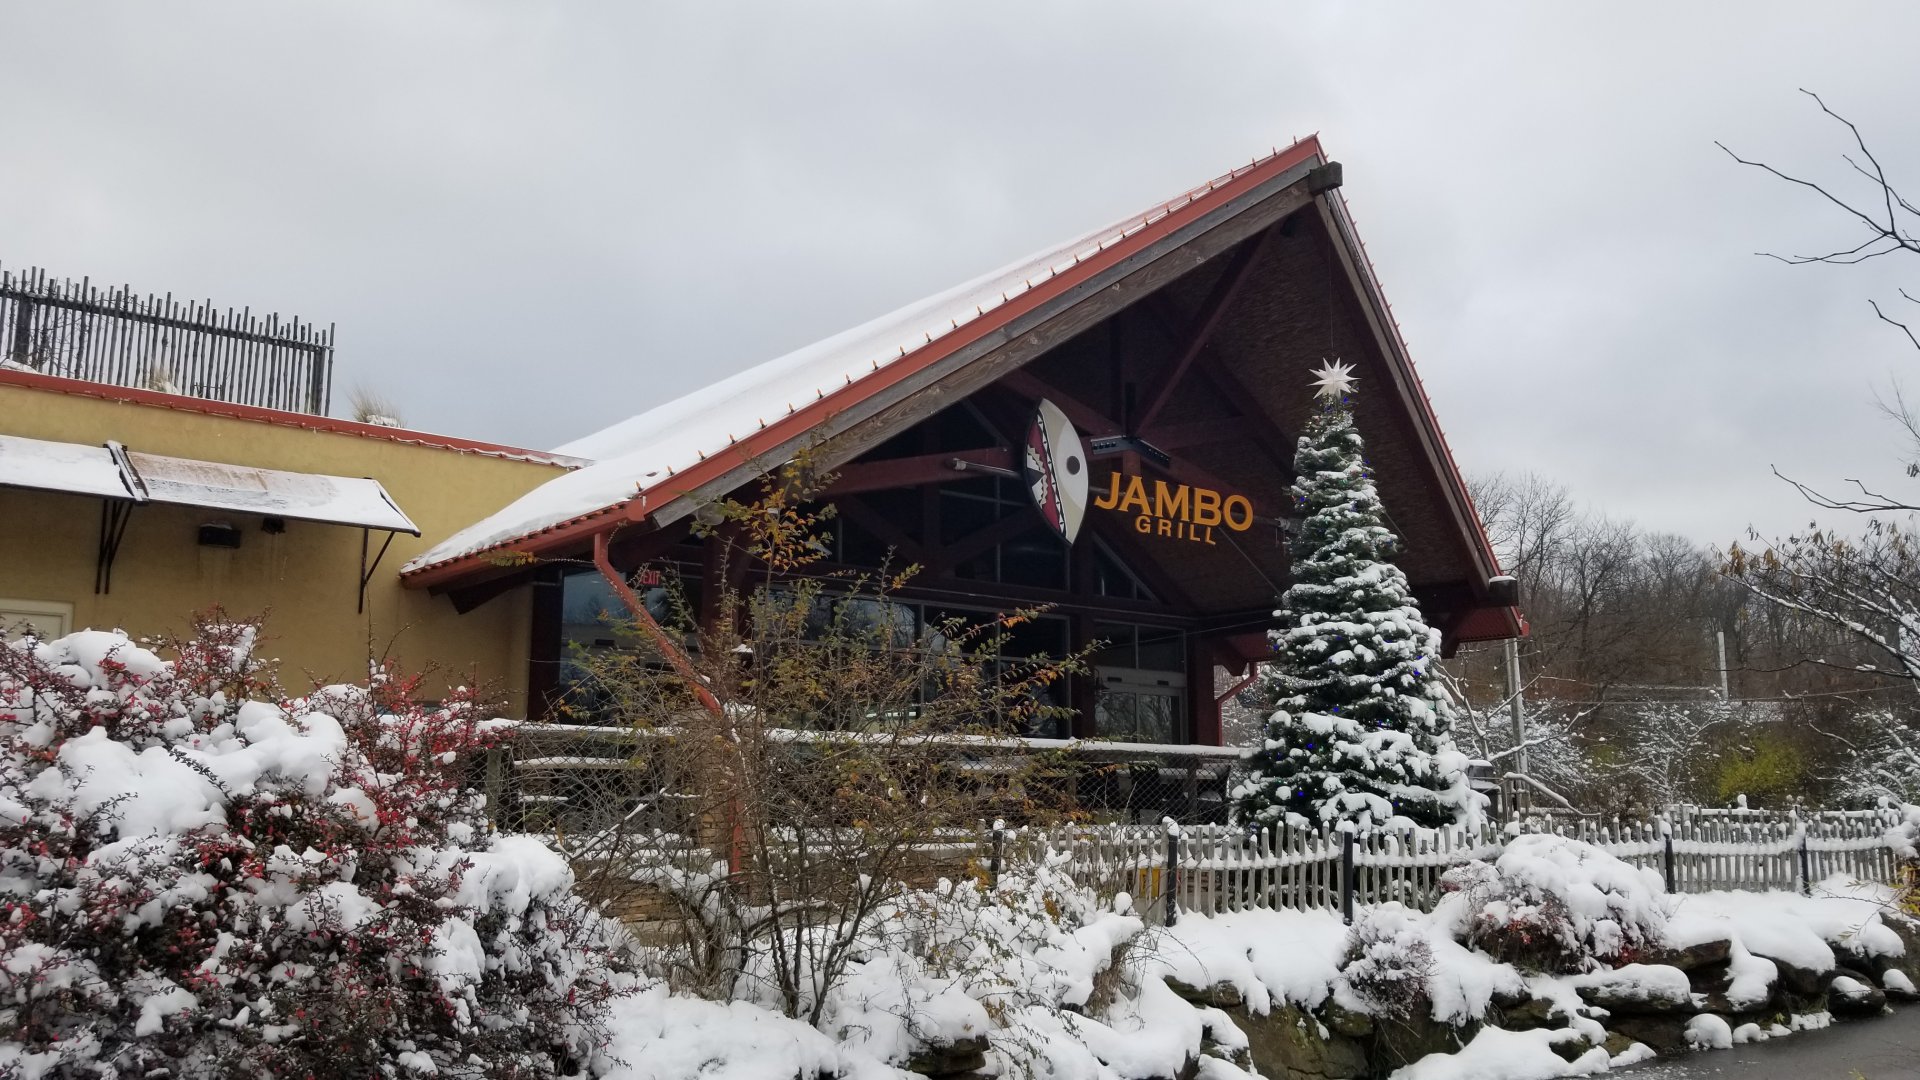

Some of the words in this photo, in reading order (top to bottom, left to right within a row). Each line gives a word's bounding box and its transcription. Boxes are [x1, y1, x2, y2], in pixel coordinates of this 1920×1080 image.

[1094, 471, 1254, 532] JAMBO
[1135, 514, 1216, 545] GRILL
[642, 570, 660, 585] EXIT
